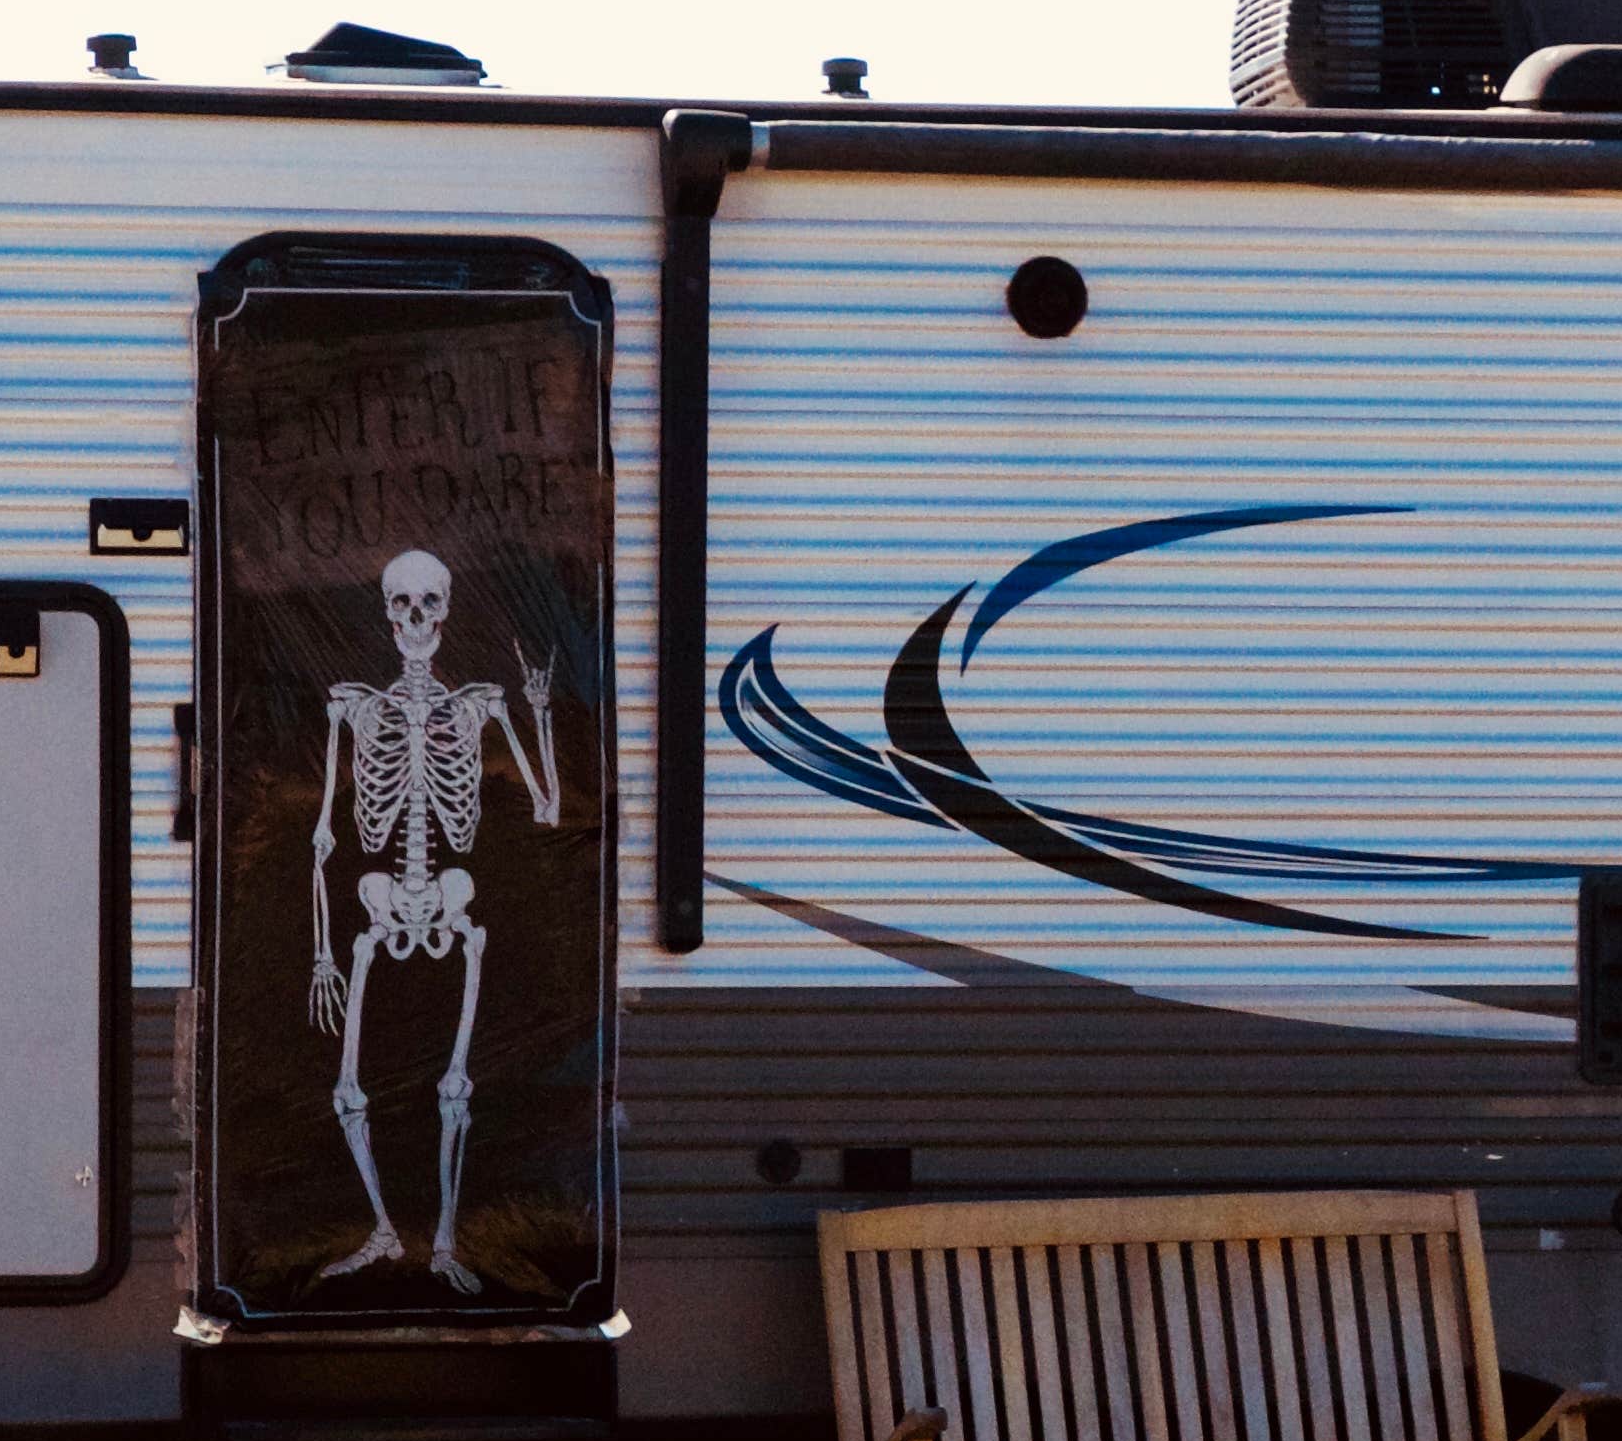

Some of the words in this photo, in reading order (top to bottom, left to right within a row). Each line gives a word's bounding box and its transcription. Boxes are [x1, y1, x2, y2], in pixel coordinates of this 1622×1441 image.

[252, 366, 483, 466] ENTER
[489, 347, 565, 438] IF
[242, 468, 387, 557] YOU
[413, 451, 577, 531] DARE
